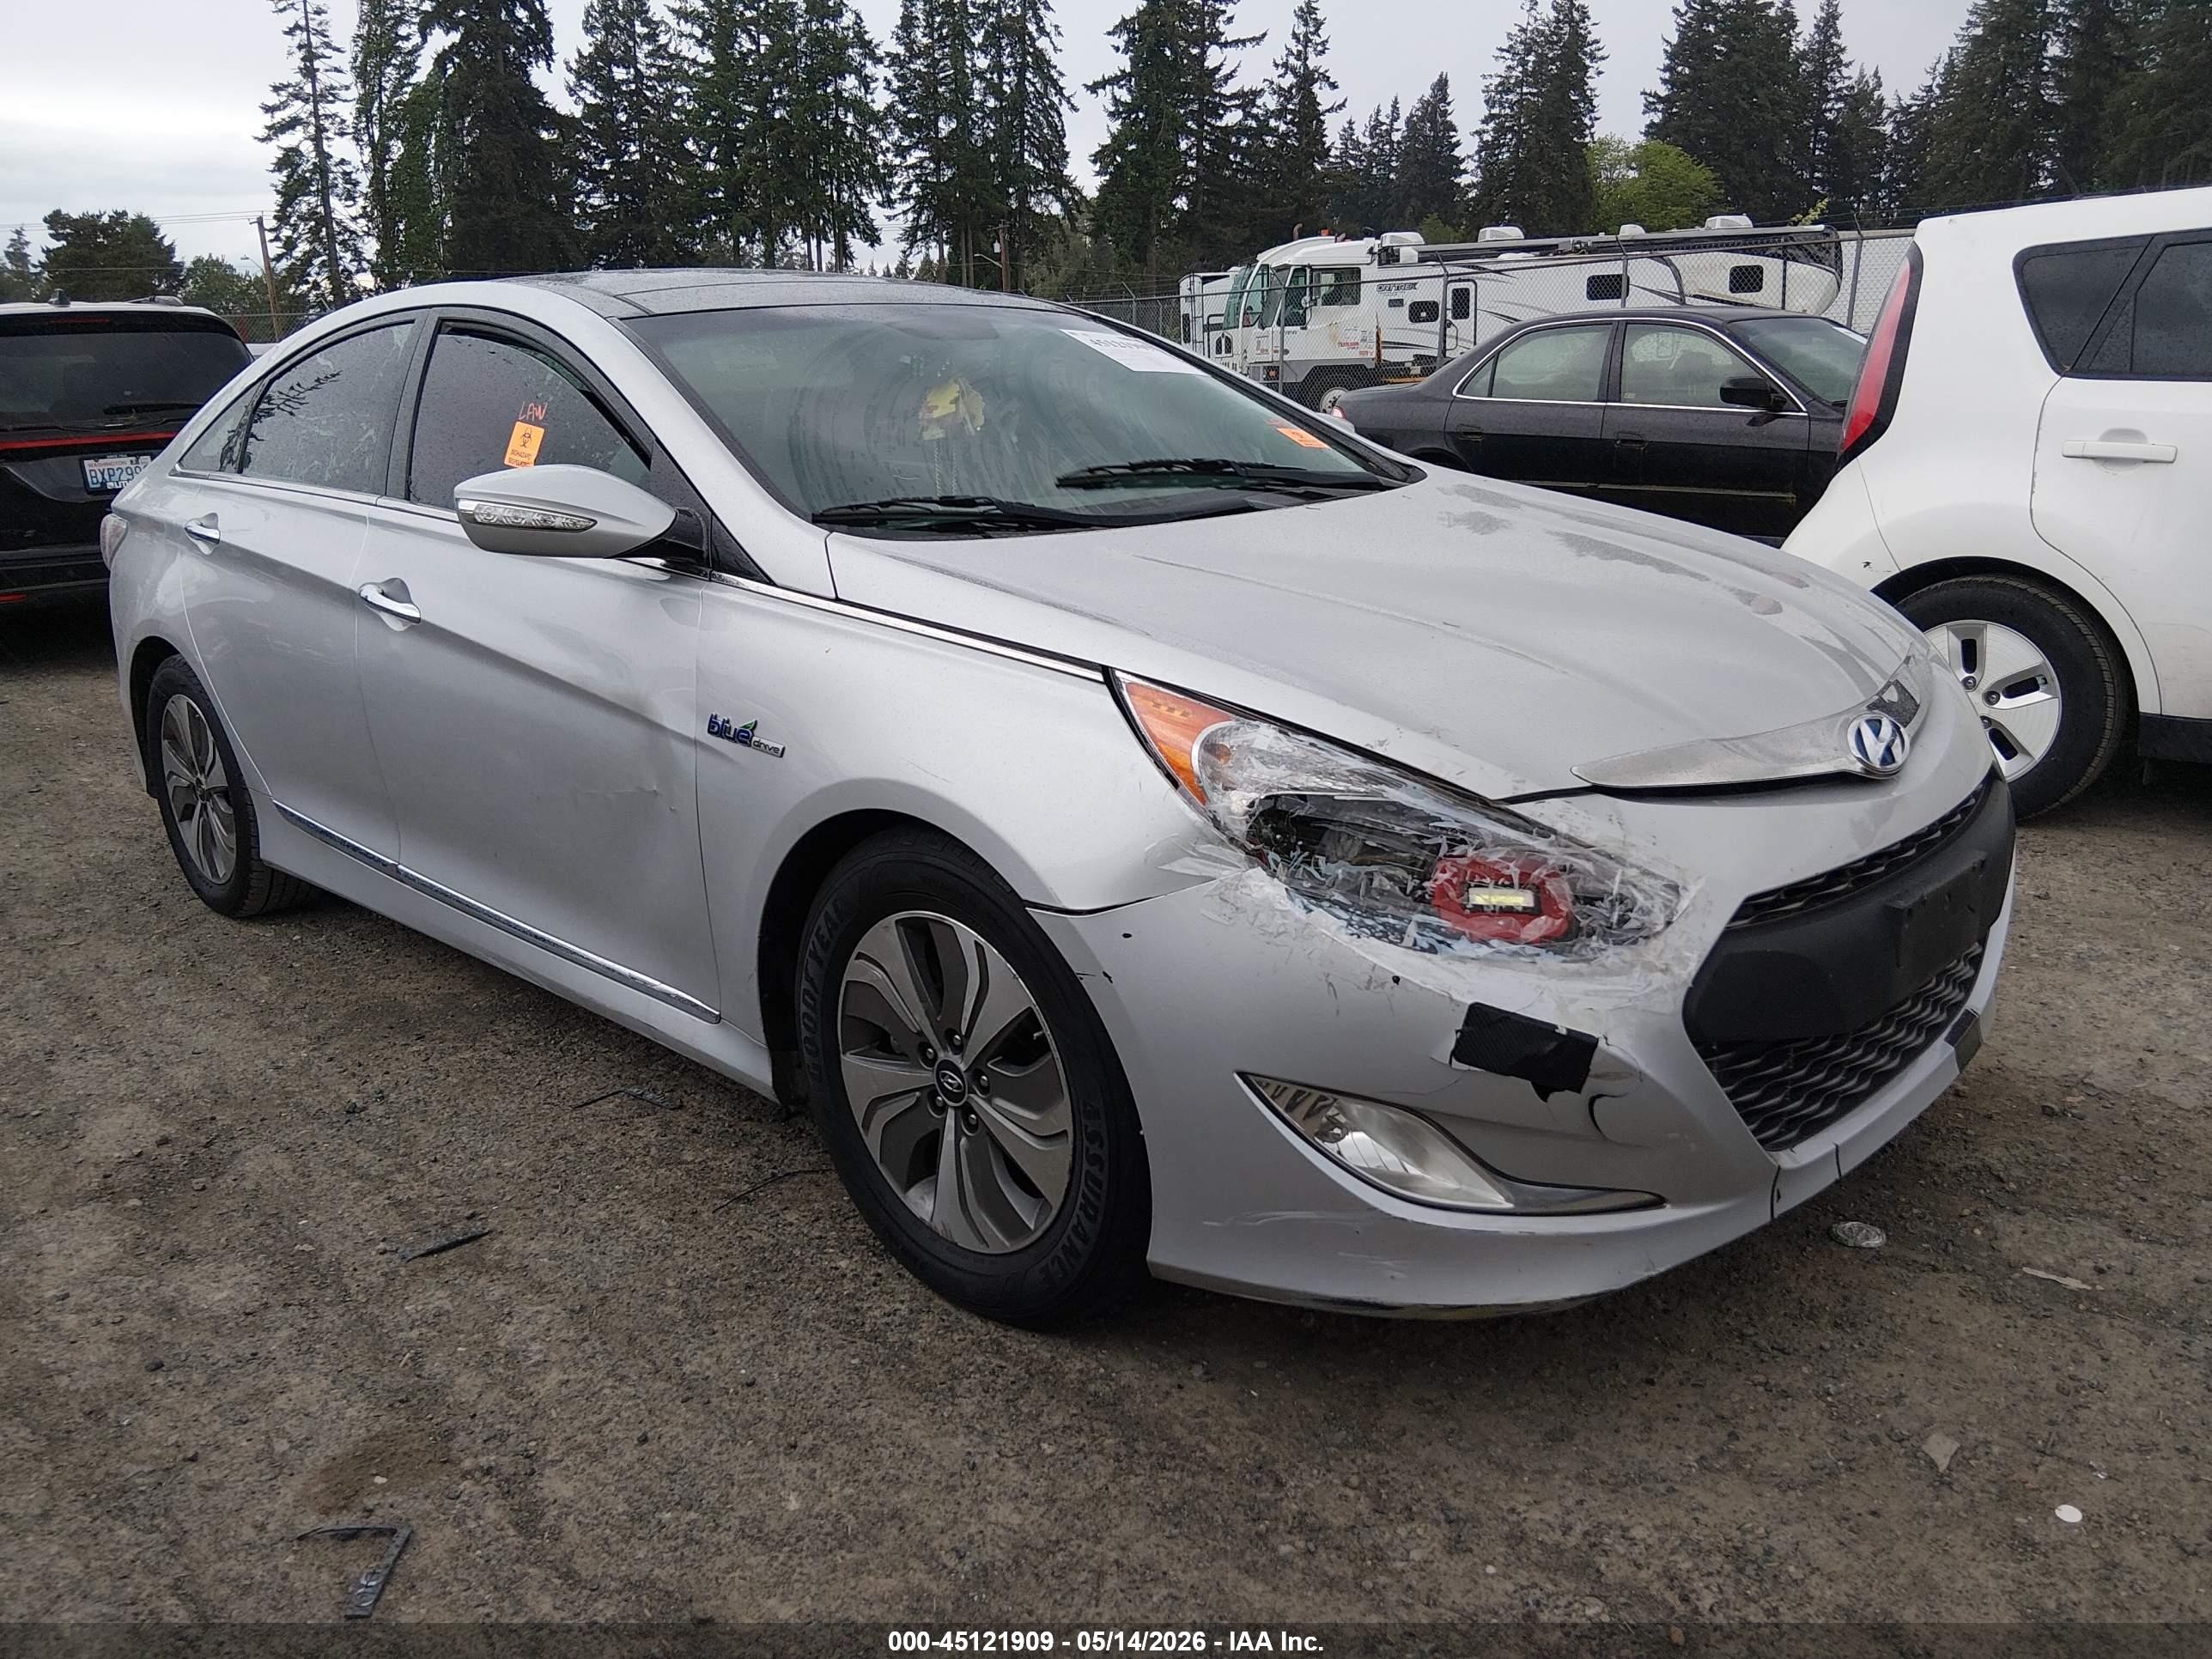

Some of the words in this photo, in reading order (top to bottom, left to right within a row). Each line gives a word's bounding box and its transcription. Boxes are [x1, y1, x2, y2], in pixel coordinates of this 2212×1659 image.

[519, 401, 549, 422] LAW
[707, 714, 755, 747] blue
[752, 738, 781, 754] drive
[1033, 1099, 1107, 1285] ASSURANCE
